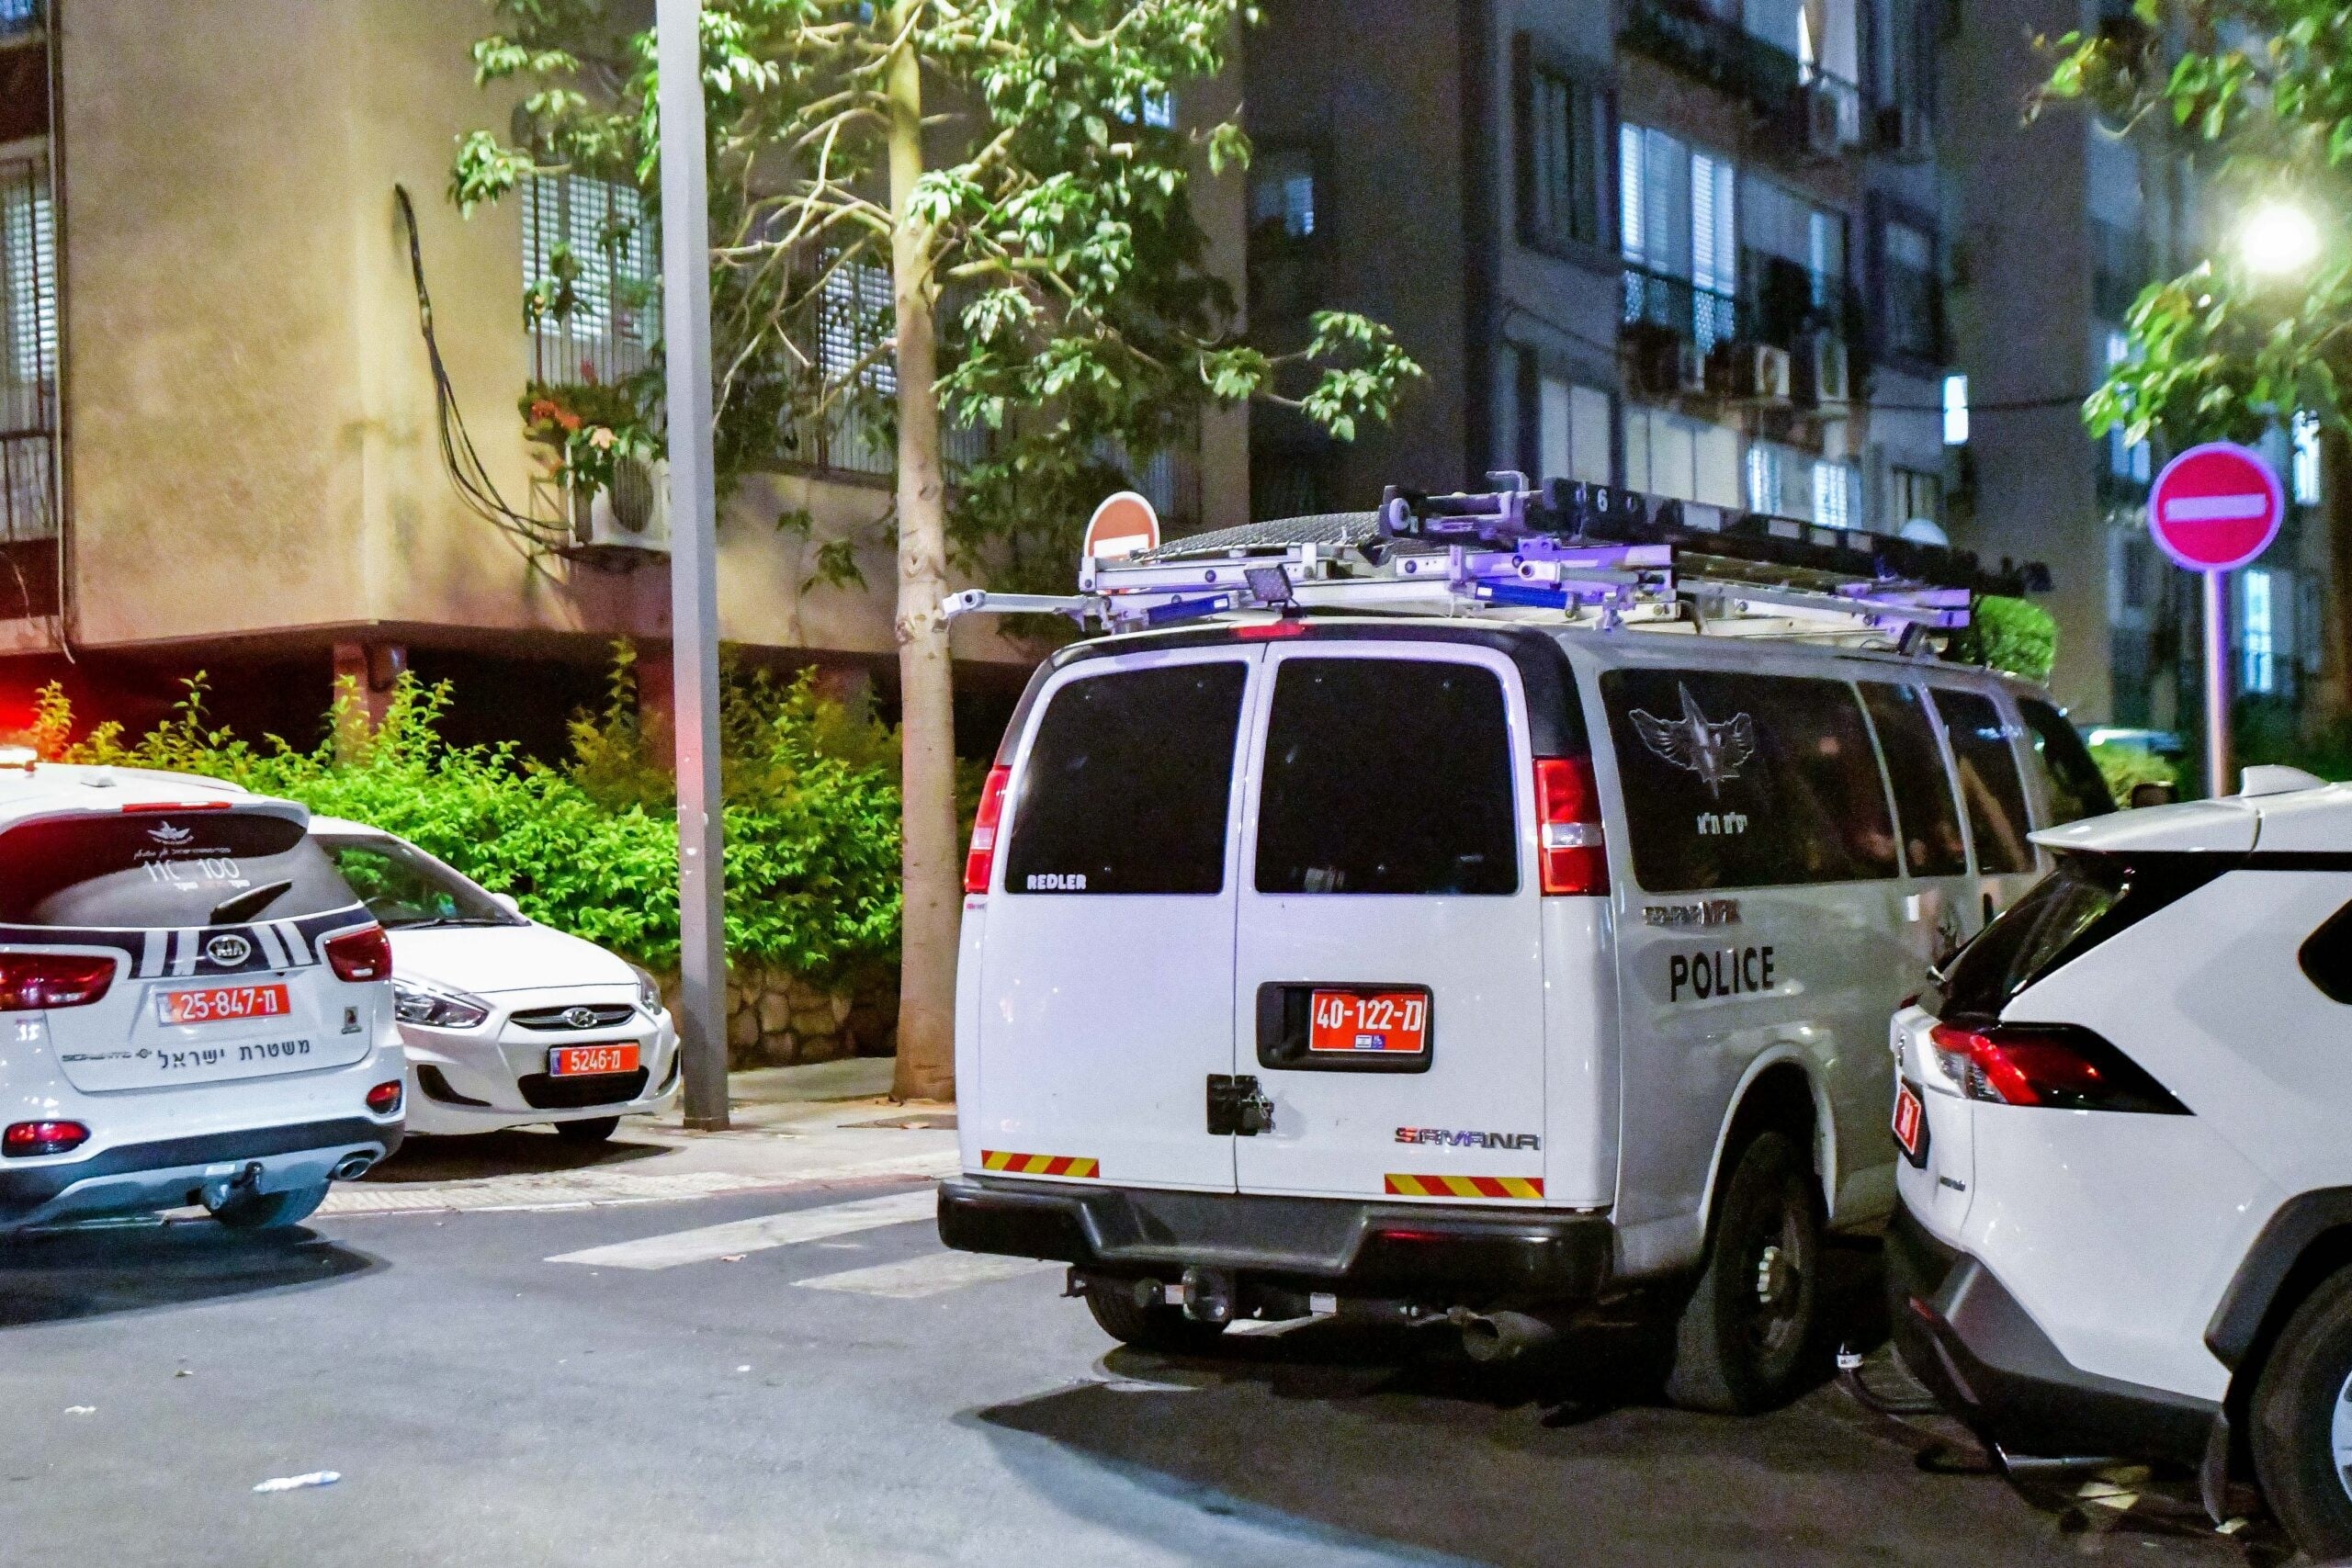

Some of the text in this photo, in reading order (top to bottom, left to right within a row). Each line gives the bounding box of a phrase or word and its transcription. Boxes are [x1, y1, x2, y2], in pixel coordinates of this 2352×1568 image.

[198, 857, 241, 879] 100
[1026, 874, 1087, 890] REDLER
[1670, 946, 1774, 1003] POLICE
[1317, 998, 1423, 1032] 40-122-מ
[157, 1048, 225, 1070] ישראל
[239, 1039, 311, 1061] משטרת
[1395, 1126, 1541, 1150] SAVANA
